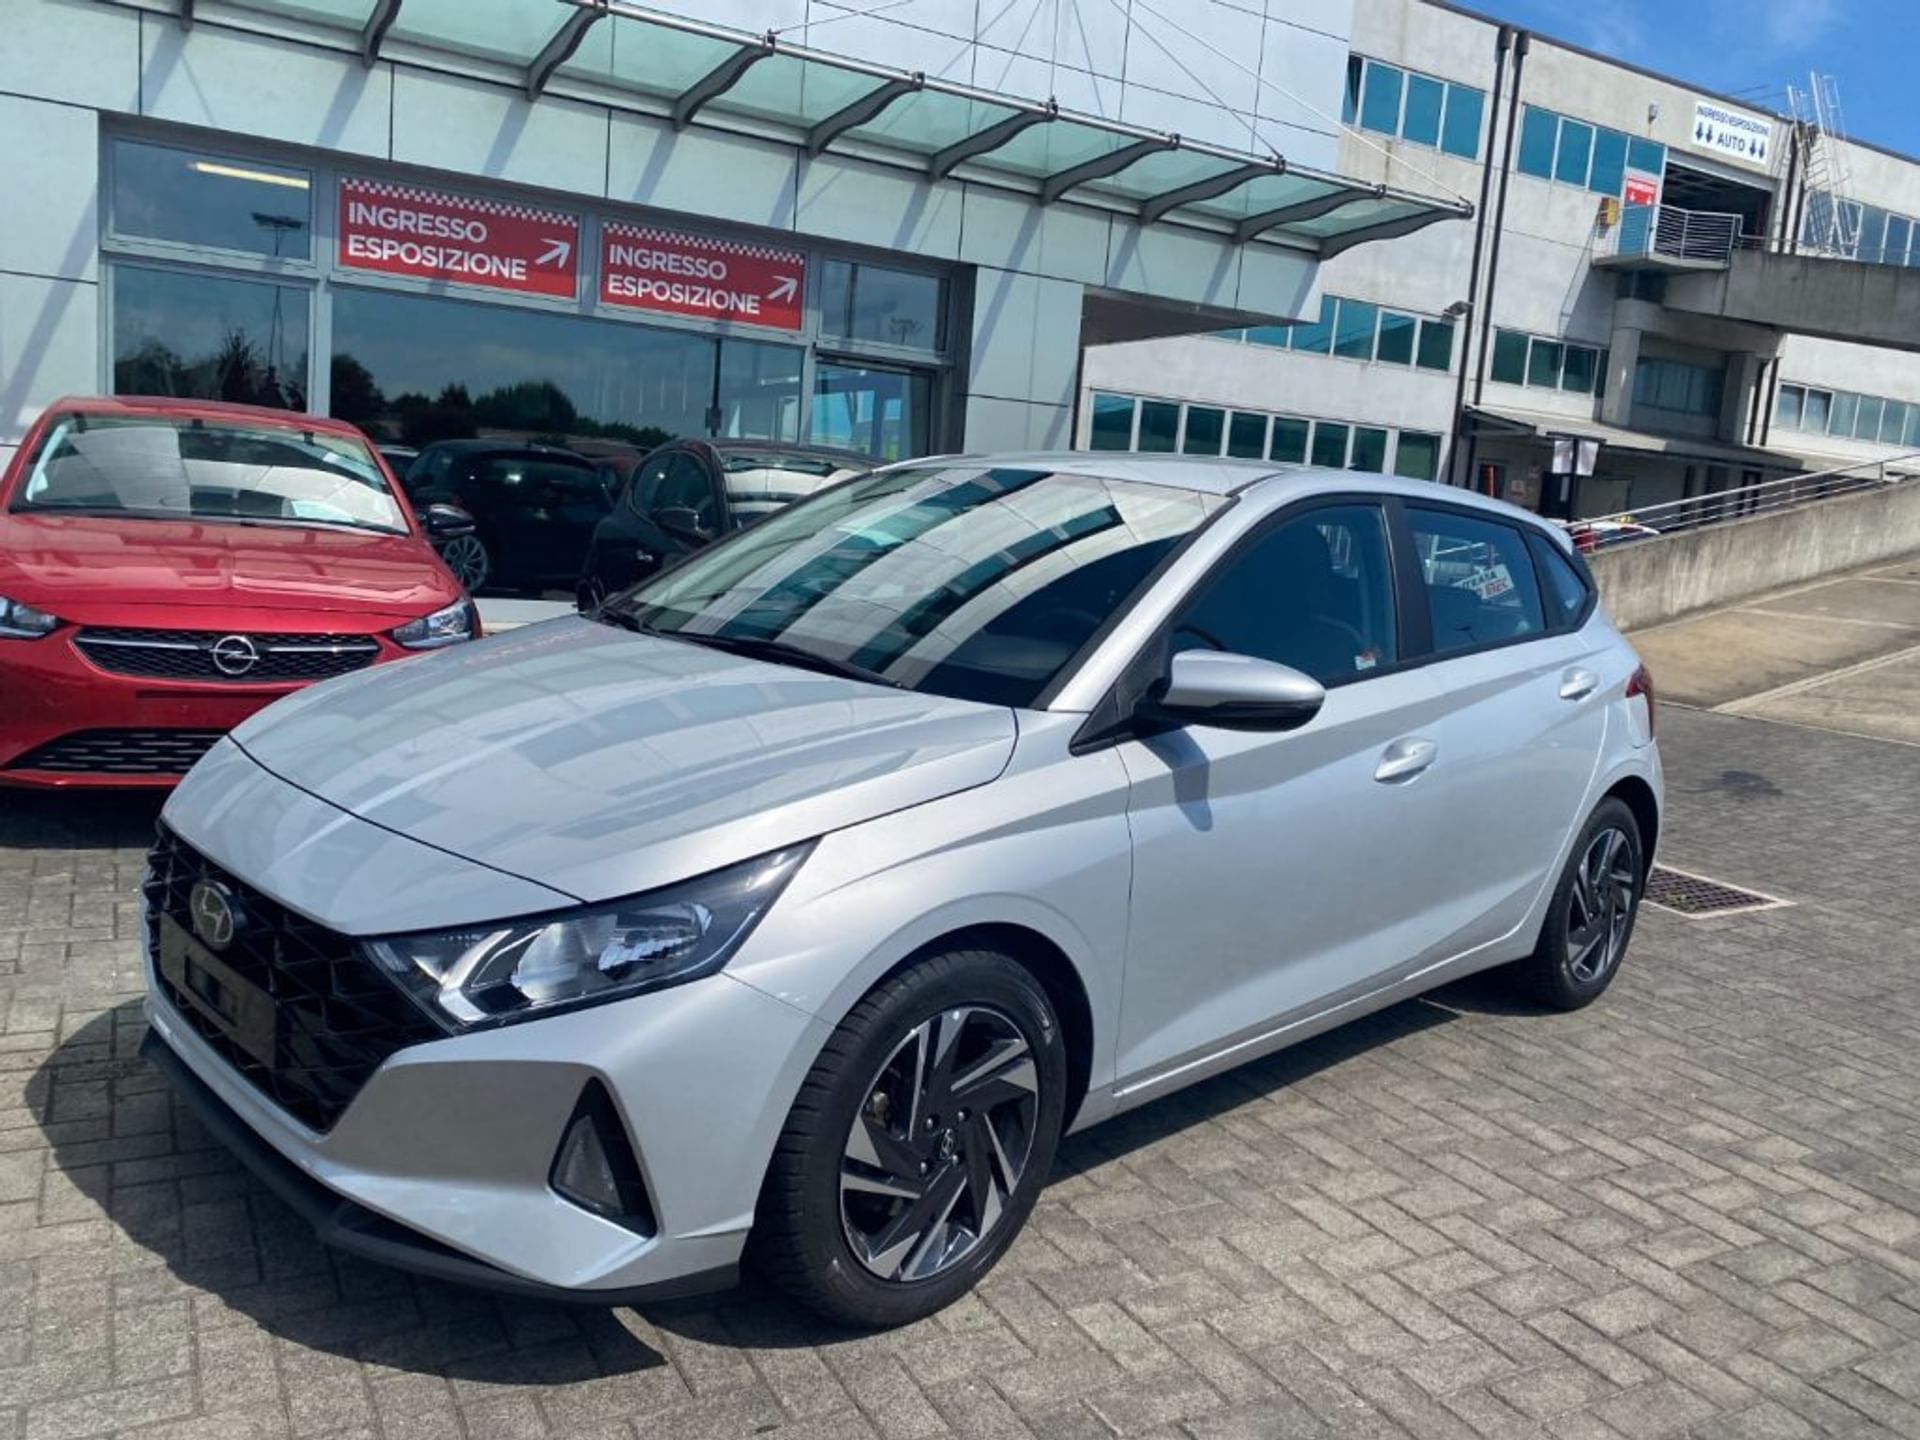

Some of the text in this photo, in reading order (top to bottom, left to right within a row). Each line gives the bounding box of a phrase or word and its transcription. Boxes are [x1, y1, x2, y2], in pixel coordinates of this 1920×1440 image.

[1717, 132, 1746, 152] AUTO
[348, 201, 488, 243] INGRESSO
[347, 235, 528, 281] ESPOSIZIONE
[608, 244, 728, 281] INGRESSO
[607, 274, 761, 315] ESPOSIZIONE
